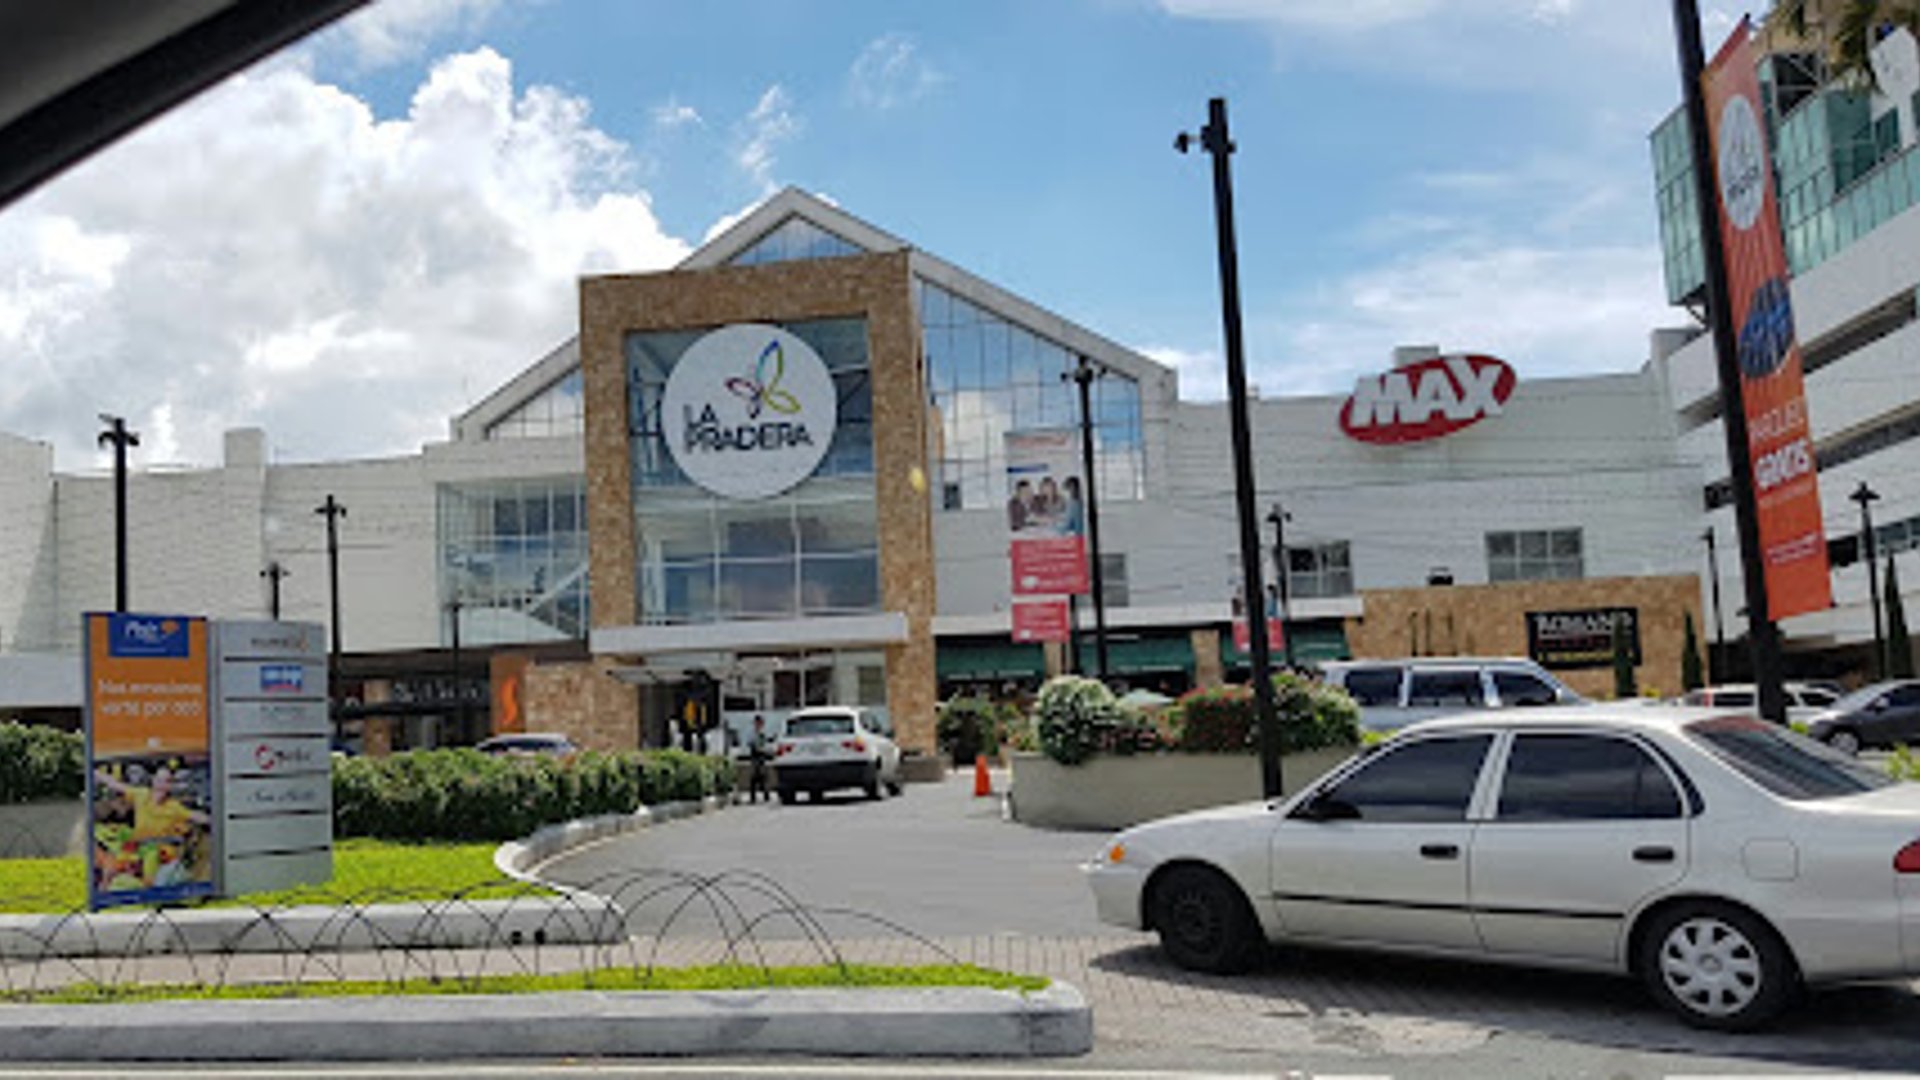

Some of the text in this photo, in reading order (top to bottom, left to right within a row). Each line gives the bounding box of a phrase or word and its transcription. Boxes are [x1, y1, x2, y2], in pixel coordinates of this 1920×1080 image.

[1350, 356, 1503, 428] MAX
[683, 403, 719, 428] LA
[683, 422, 814, 454] PRADERA
